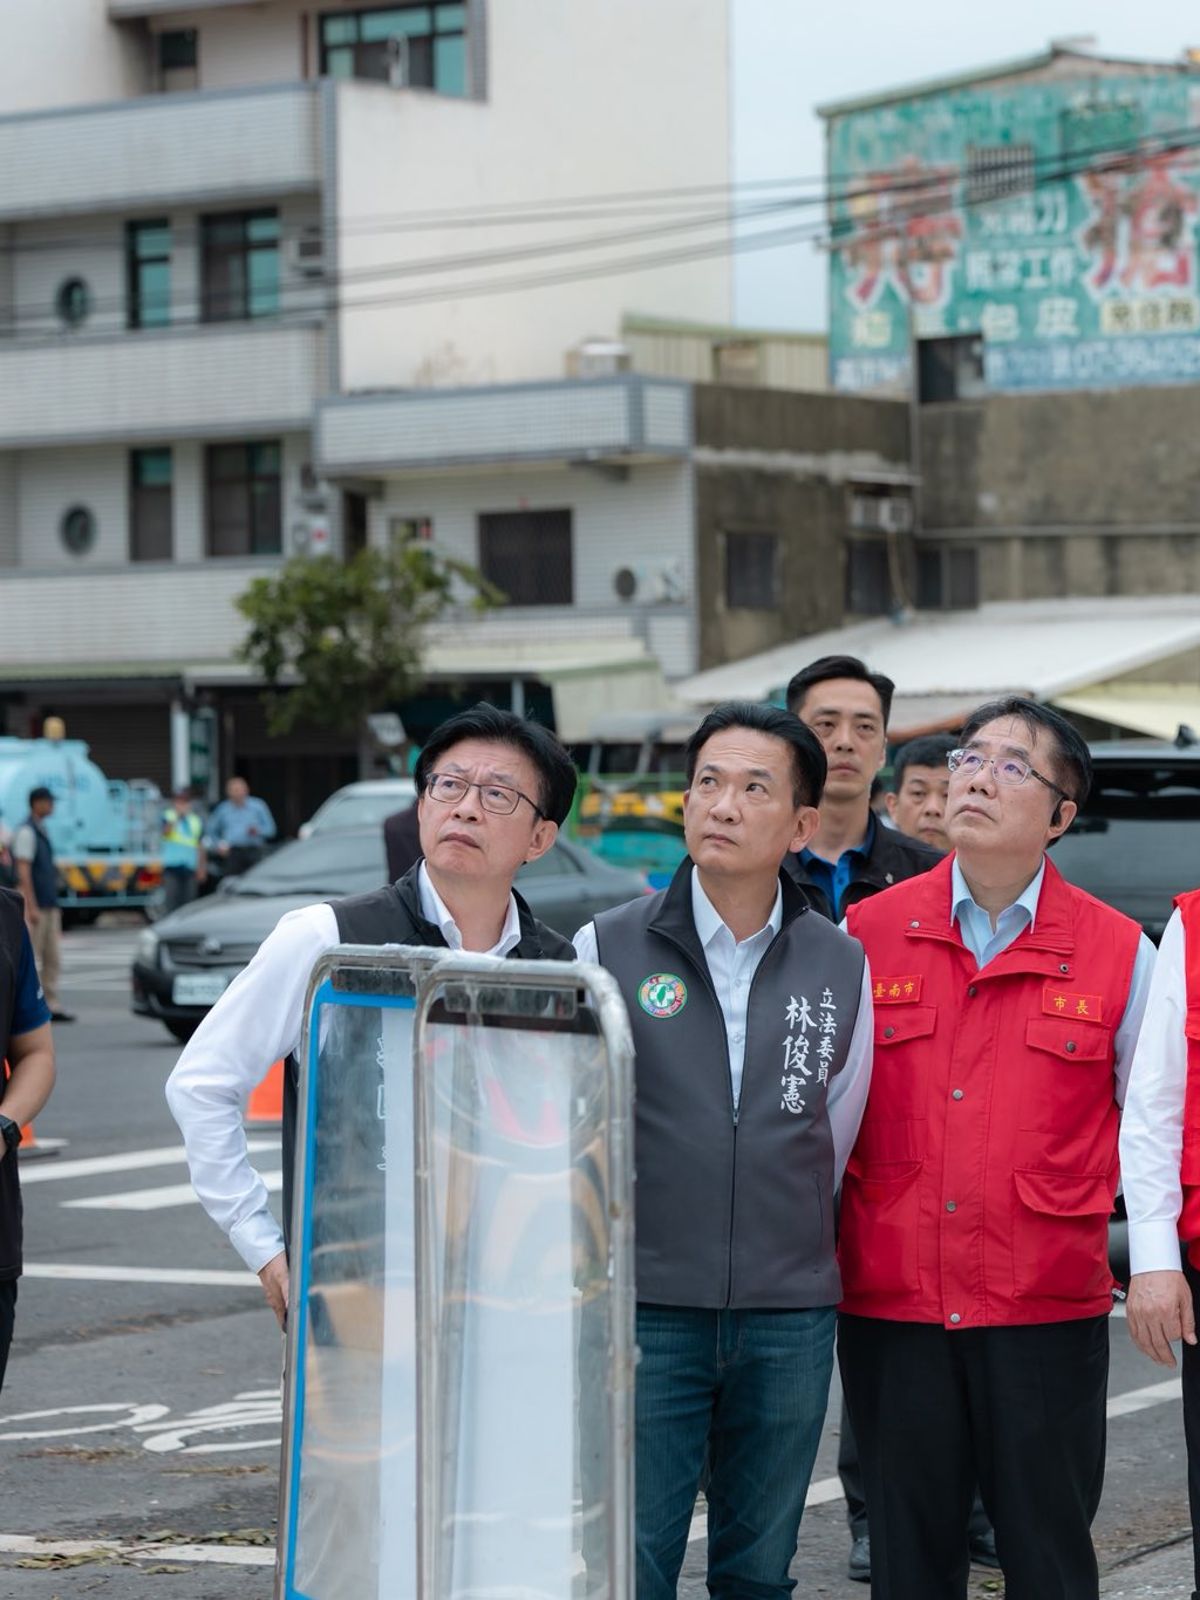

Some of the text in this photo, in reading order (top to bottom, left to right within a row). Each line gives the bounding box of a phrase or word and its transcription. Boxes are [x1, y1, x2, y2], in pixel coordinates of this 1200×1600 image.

[873, 981, 914, 999] 臺南市
[1053, 995, 1089, 1015] 市長
[780, 995, 817, 1114] 林俊憲
[816, 987, 837, 1088] 立法委員
